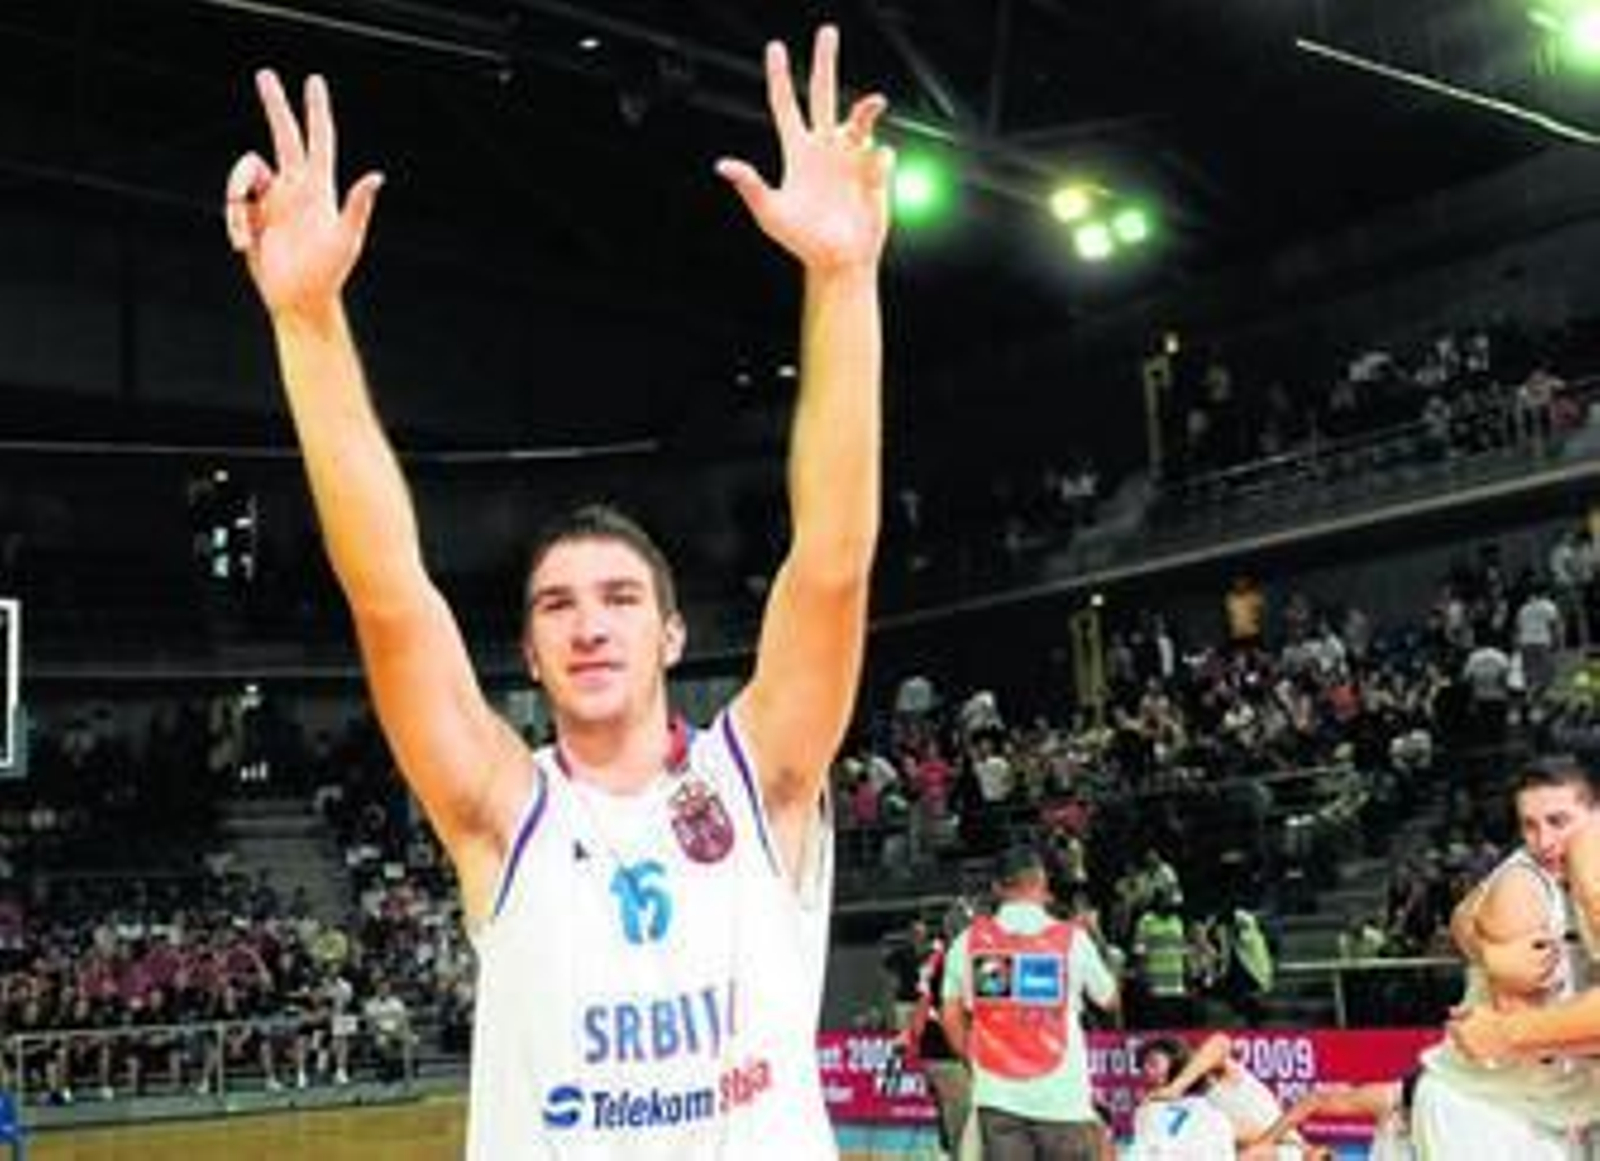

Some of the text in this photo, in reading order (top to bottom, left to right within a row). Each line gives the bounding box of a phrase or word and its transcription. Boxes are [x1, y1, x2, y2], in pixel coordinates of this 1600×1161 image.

[584, 979, 736, 1064] SRBIJ
[1234, 1038, 1314, 1079] 2009
[591, 1088, 715, 1130] Telekom
[1164, 1106, 1189, 1137] 7
